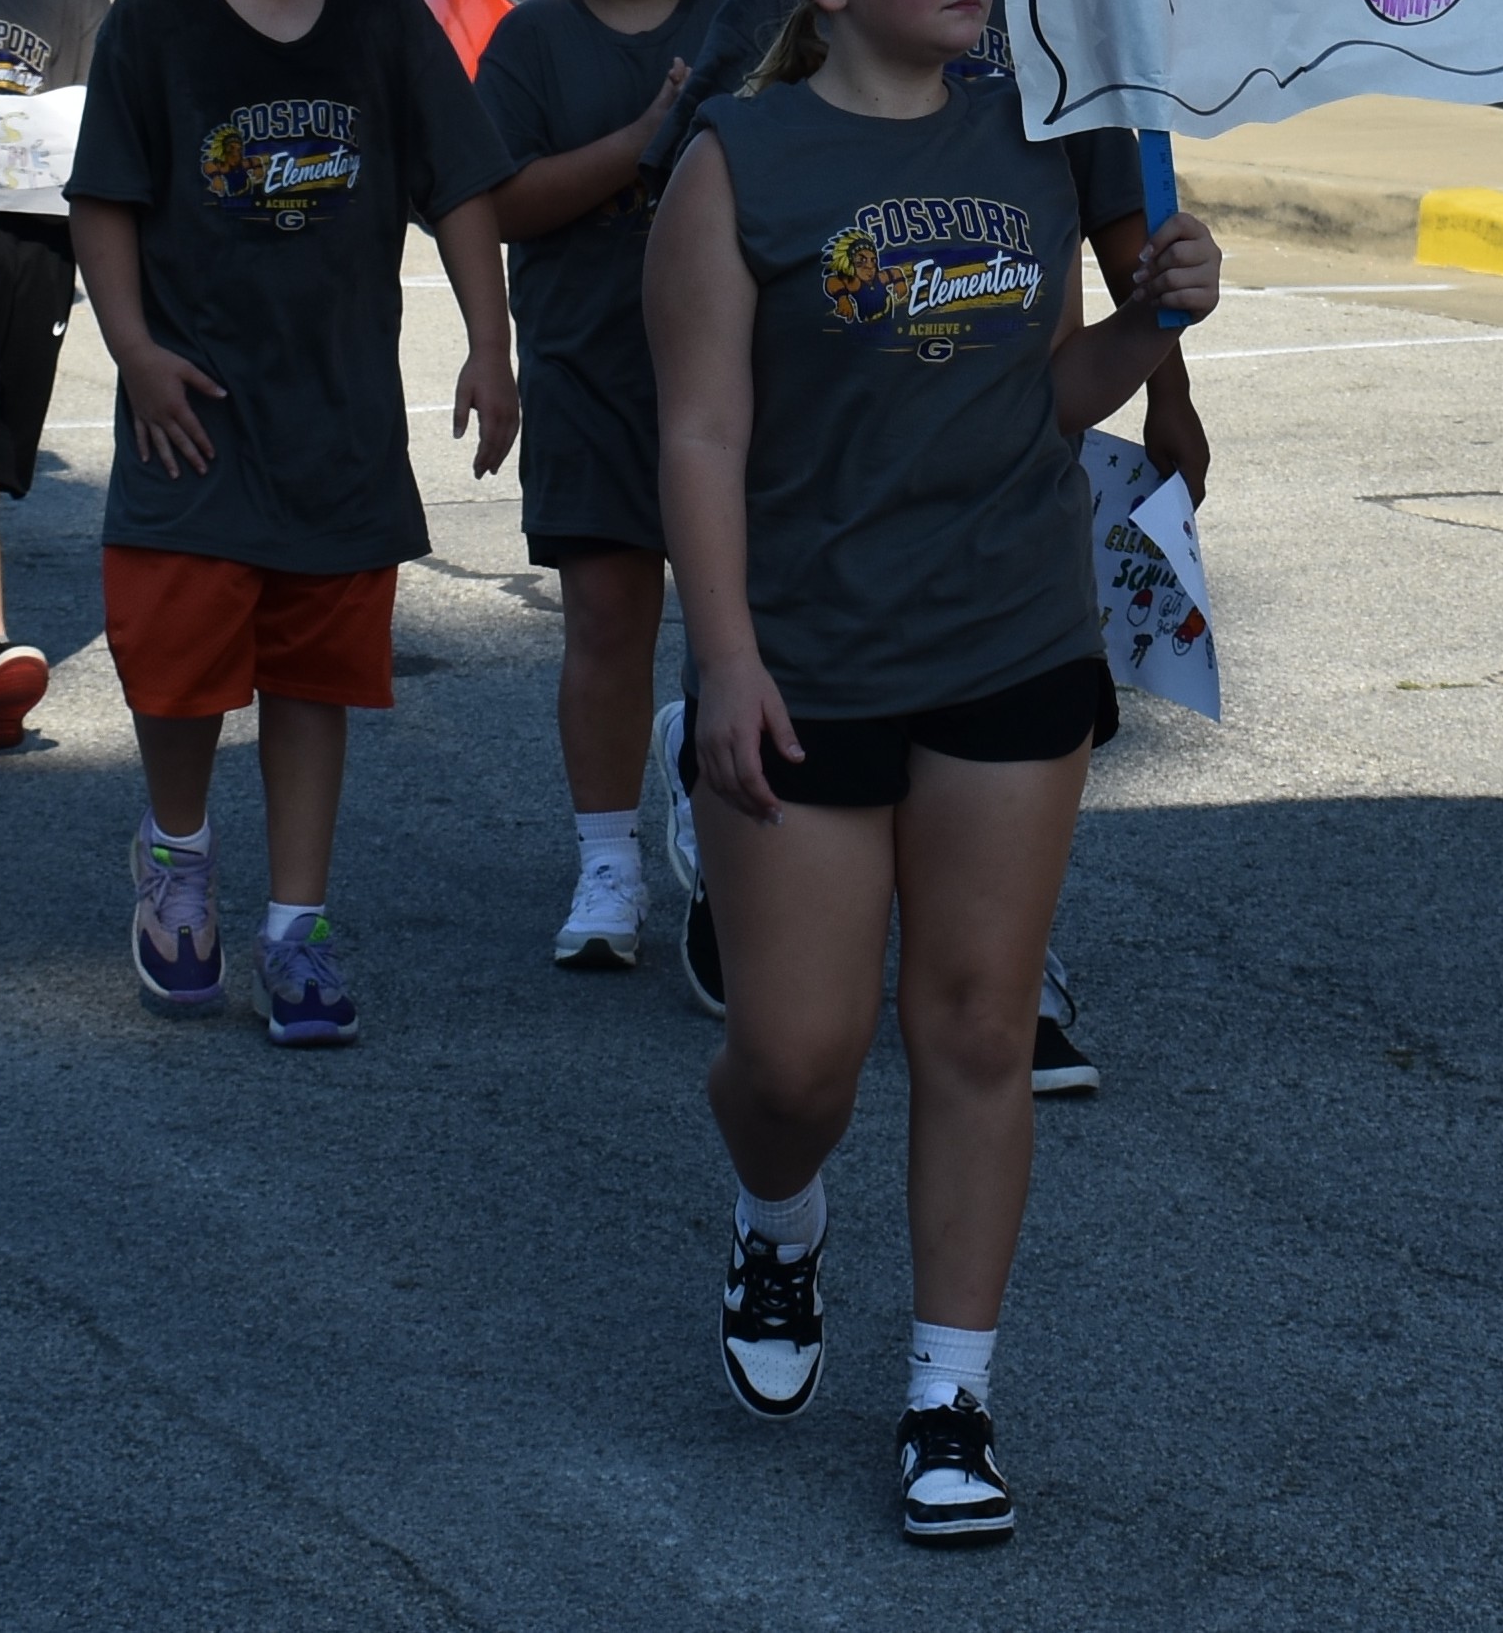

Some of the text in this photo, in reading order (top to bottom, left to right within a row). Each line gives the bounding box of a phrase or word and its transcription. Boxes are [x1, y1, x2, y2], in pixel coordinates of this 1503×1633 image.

[264, 144, 362, 194] Elementary
[265, 199, 309, 209] ACHIEVE
[276, 210, 305, 230] G
[855, 197, 1034, 255] GOSPORT
[908, 250, 1043, 317] Elementary
[908, 322, 961, 336] ACHIEVE
[917, 336, 954, 363] G
